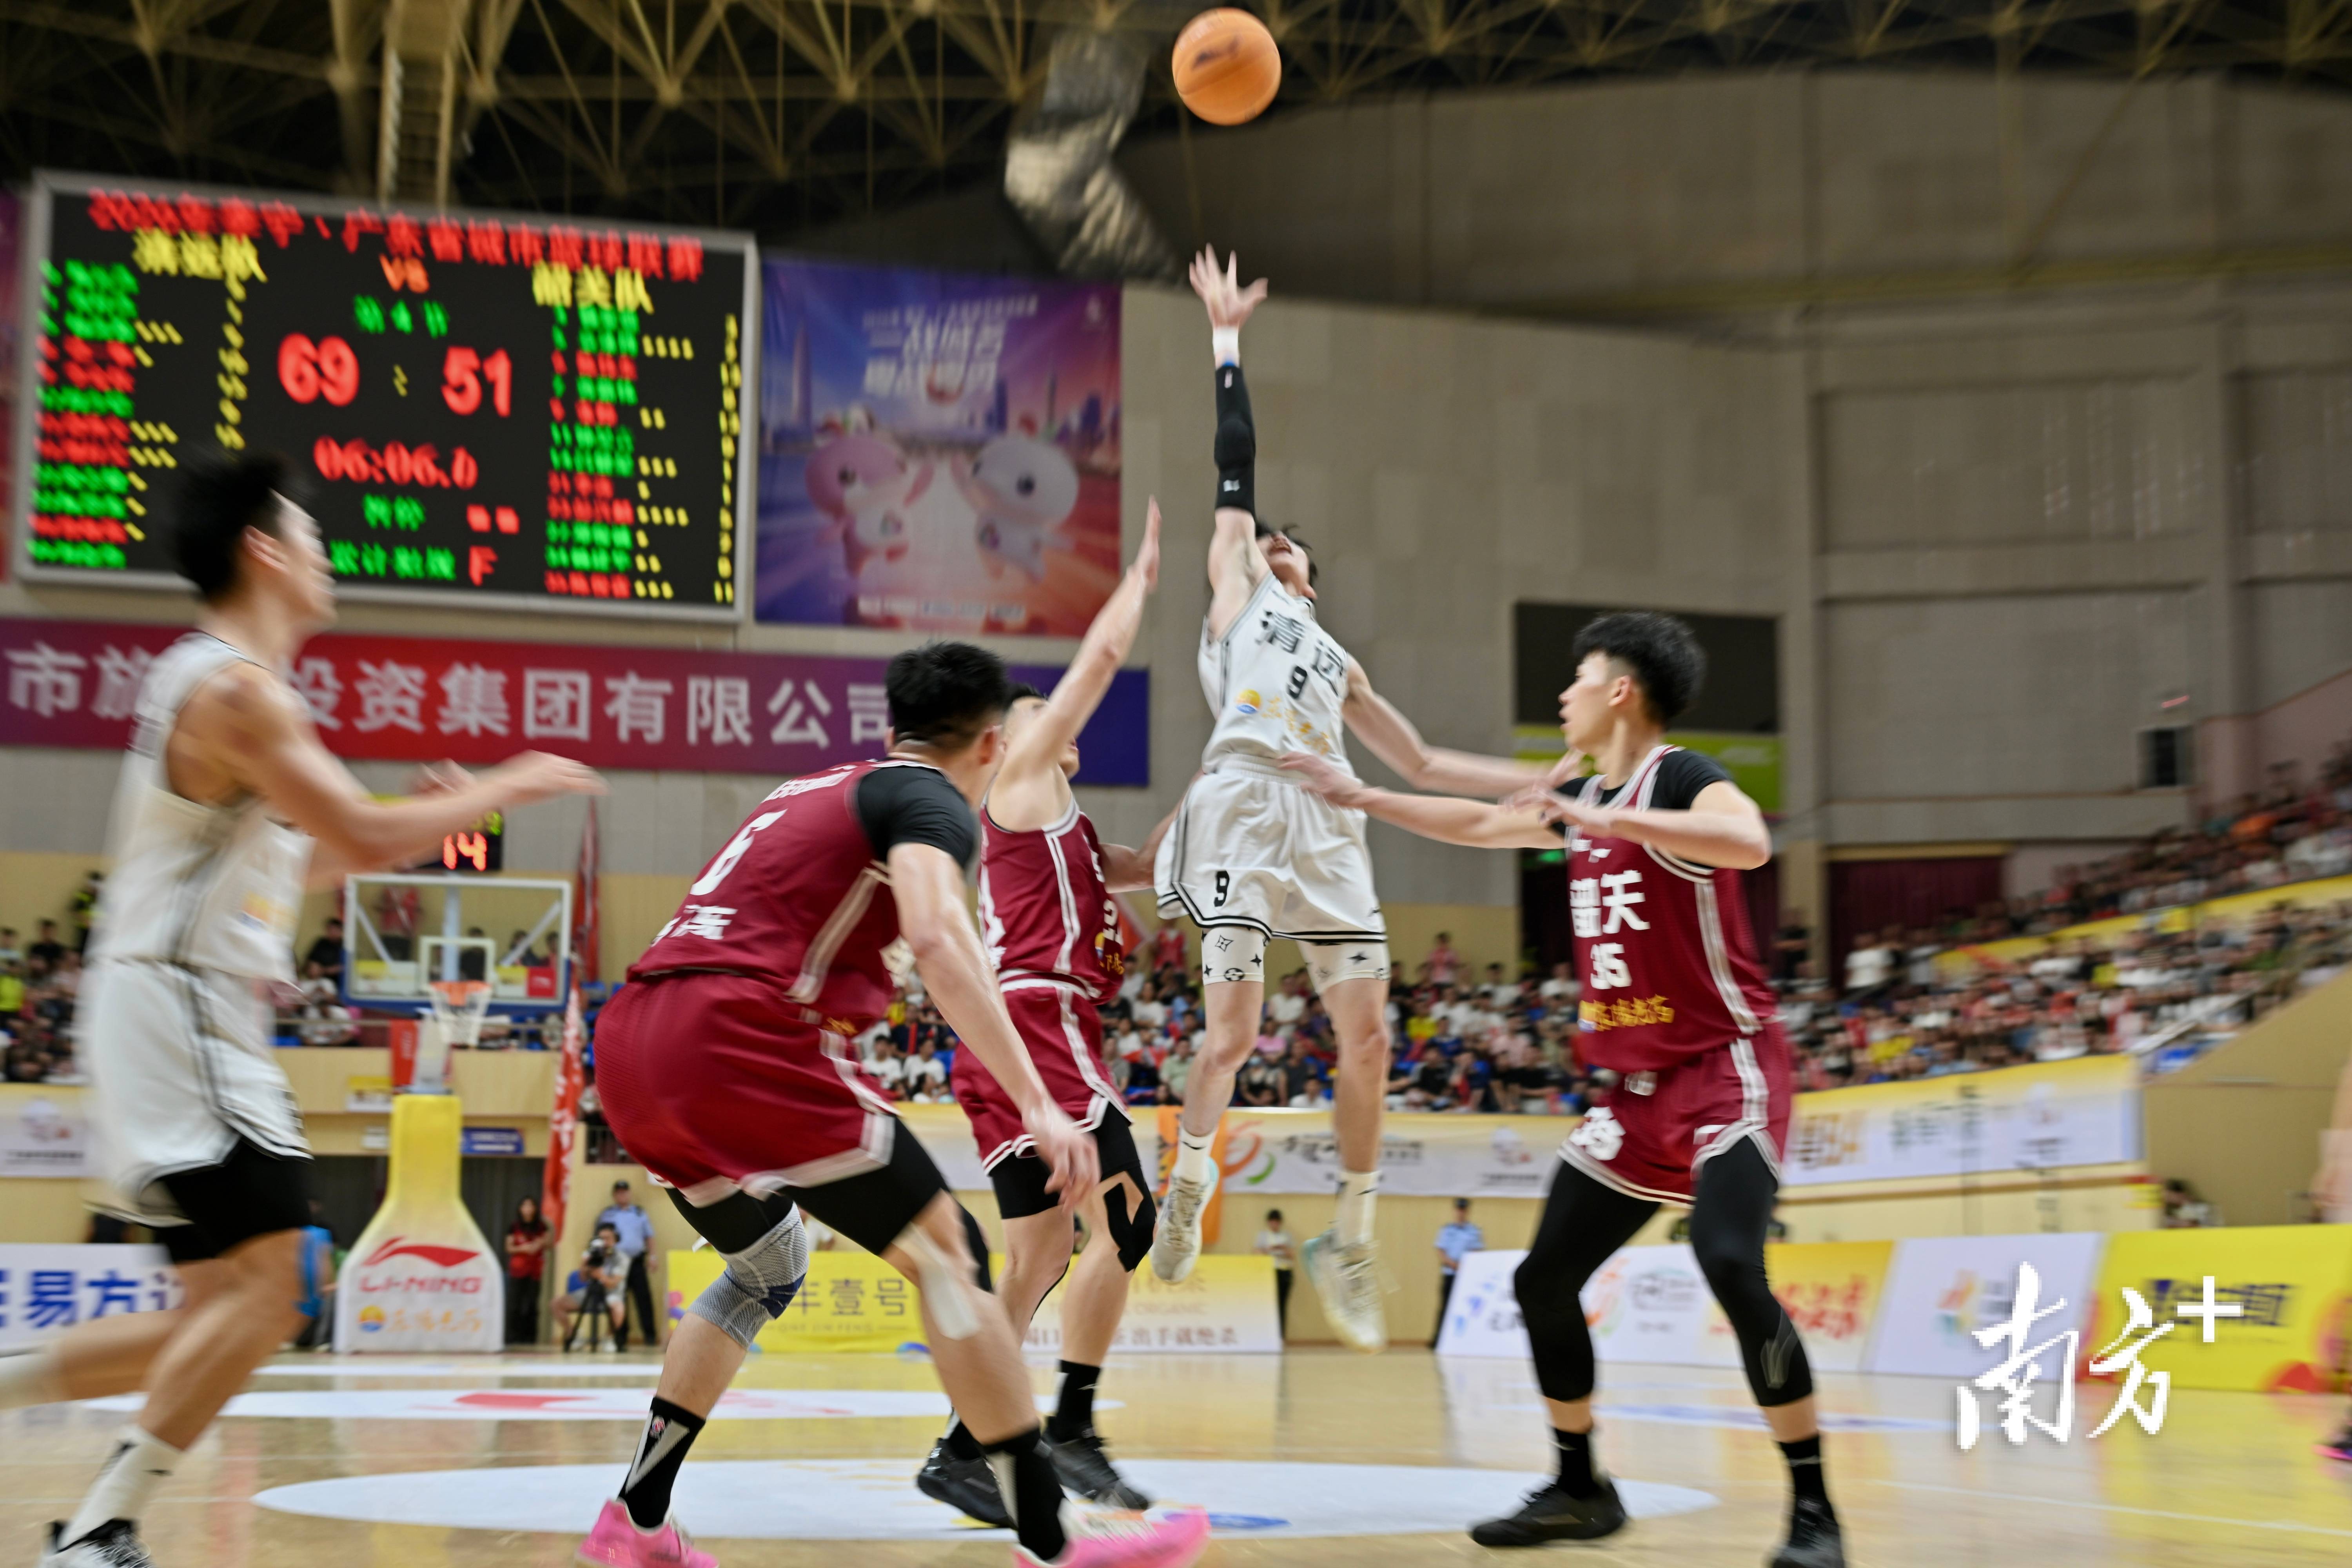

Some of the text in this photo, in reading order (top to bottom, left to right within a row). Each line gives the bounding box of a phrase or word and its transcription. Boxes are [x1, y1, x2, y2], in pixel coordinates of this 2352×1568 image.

[278, 332, 359, 407] 69
[441, 346, 512, 417] 51
[1286, 665, 1308, 700] 9
[443, 831, 488, 872] 14
[1214, 870, 1230, 907] 9
[1590, 942, 1633, 990] 35
[358, 1276, 485, 1294] LI-NING
